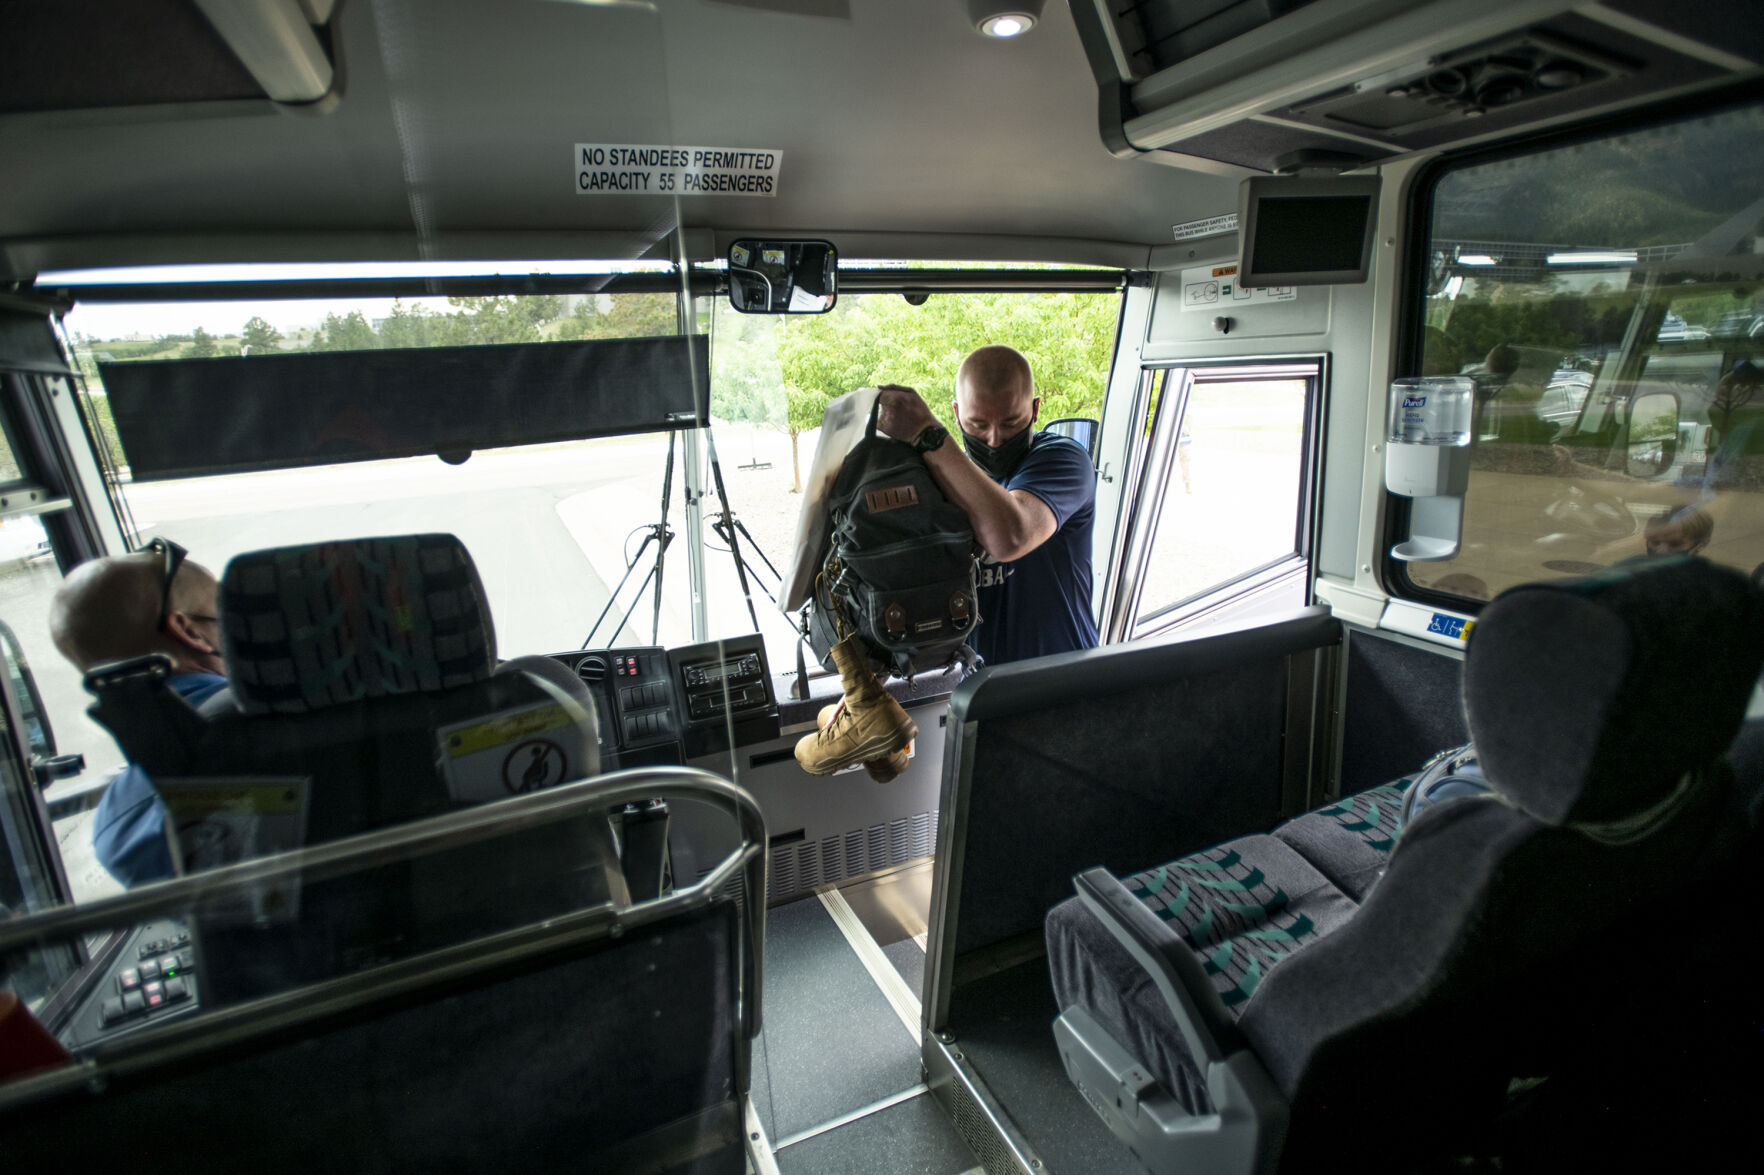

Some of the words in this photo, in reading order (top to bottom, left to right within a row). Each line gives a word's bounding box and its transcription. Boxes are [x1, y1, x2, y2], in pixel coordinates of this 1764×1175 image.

[582, 147, 605, 166] NO
[609, 148, 689, 167] STANDEES
[693, 150, 774, 170] PERMITTED
[579, 171, 651, 190] CAPACITY
[659, 172, 675, 191] 55
[684, 173, 773, 193] PASSENGERS
[1183, 221, 1209, 230] PASSENGER
